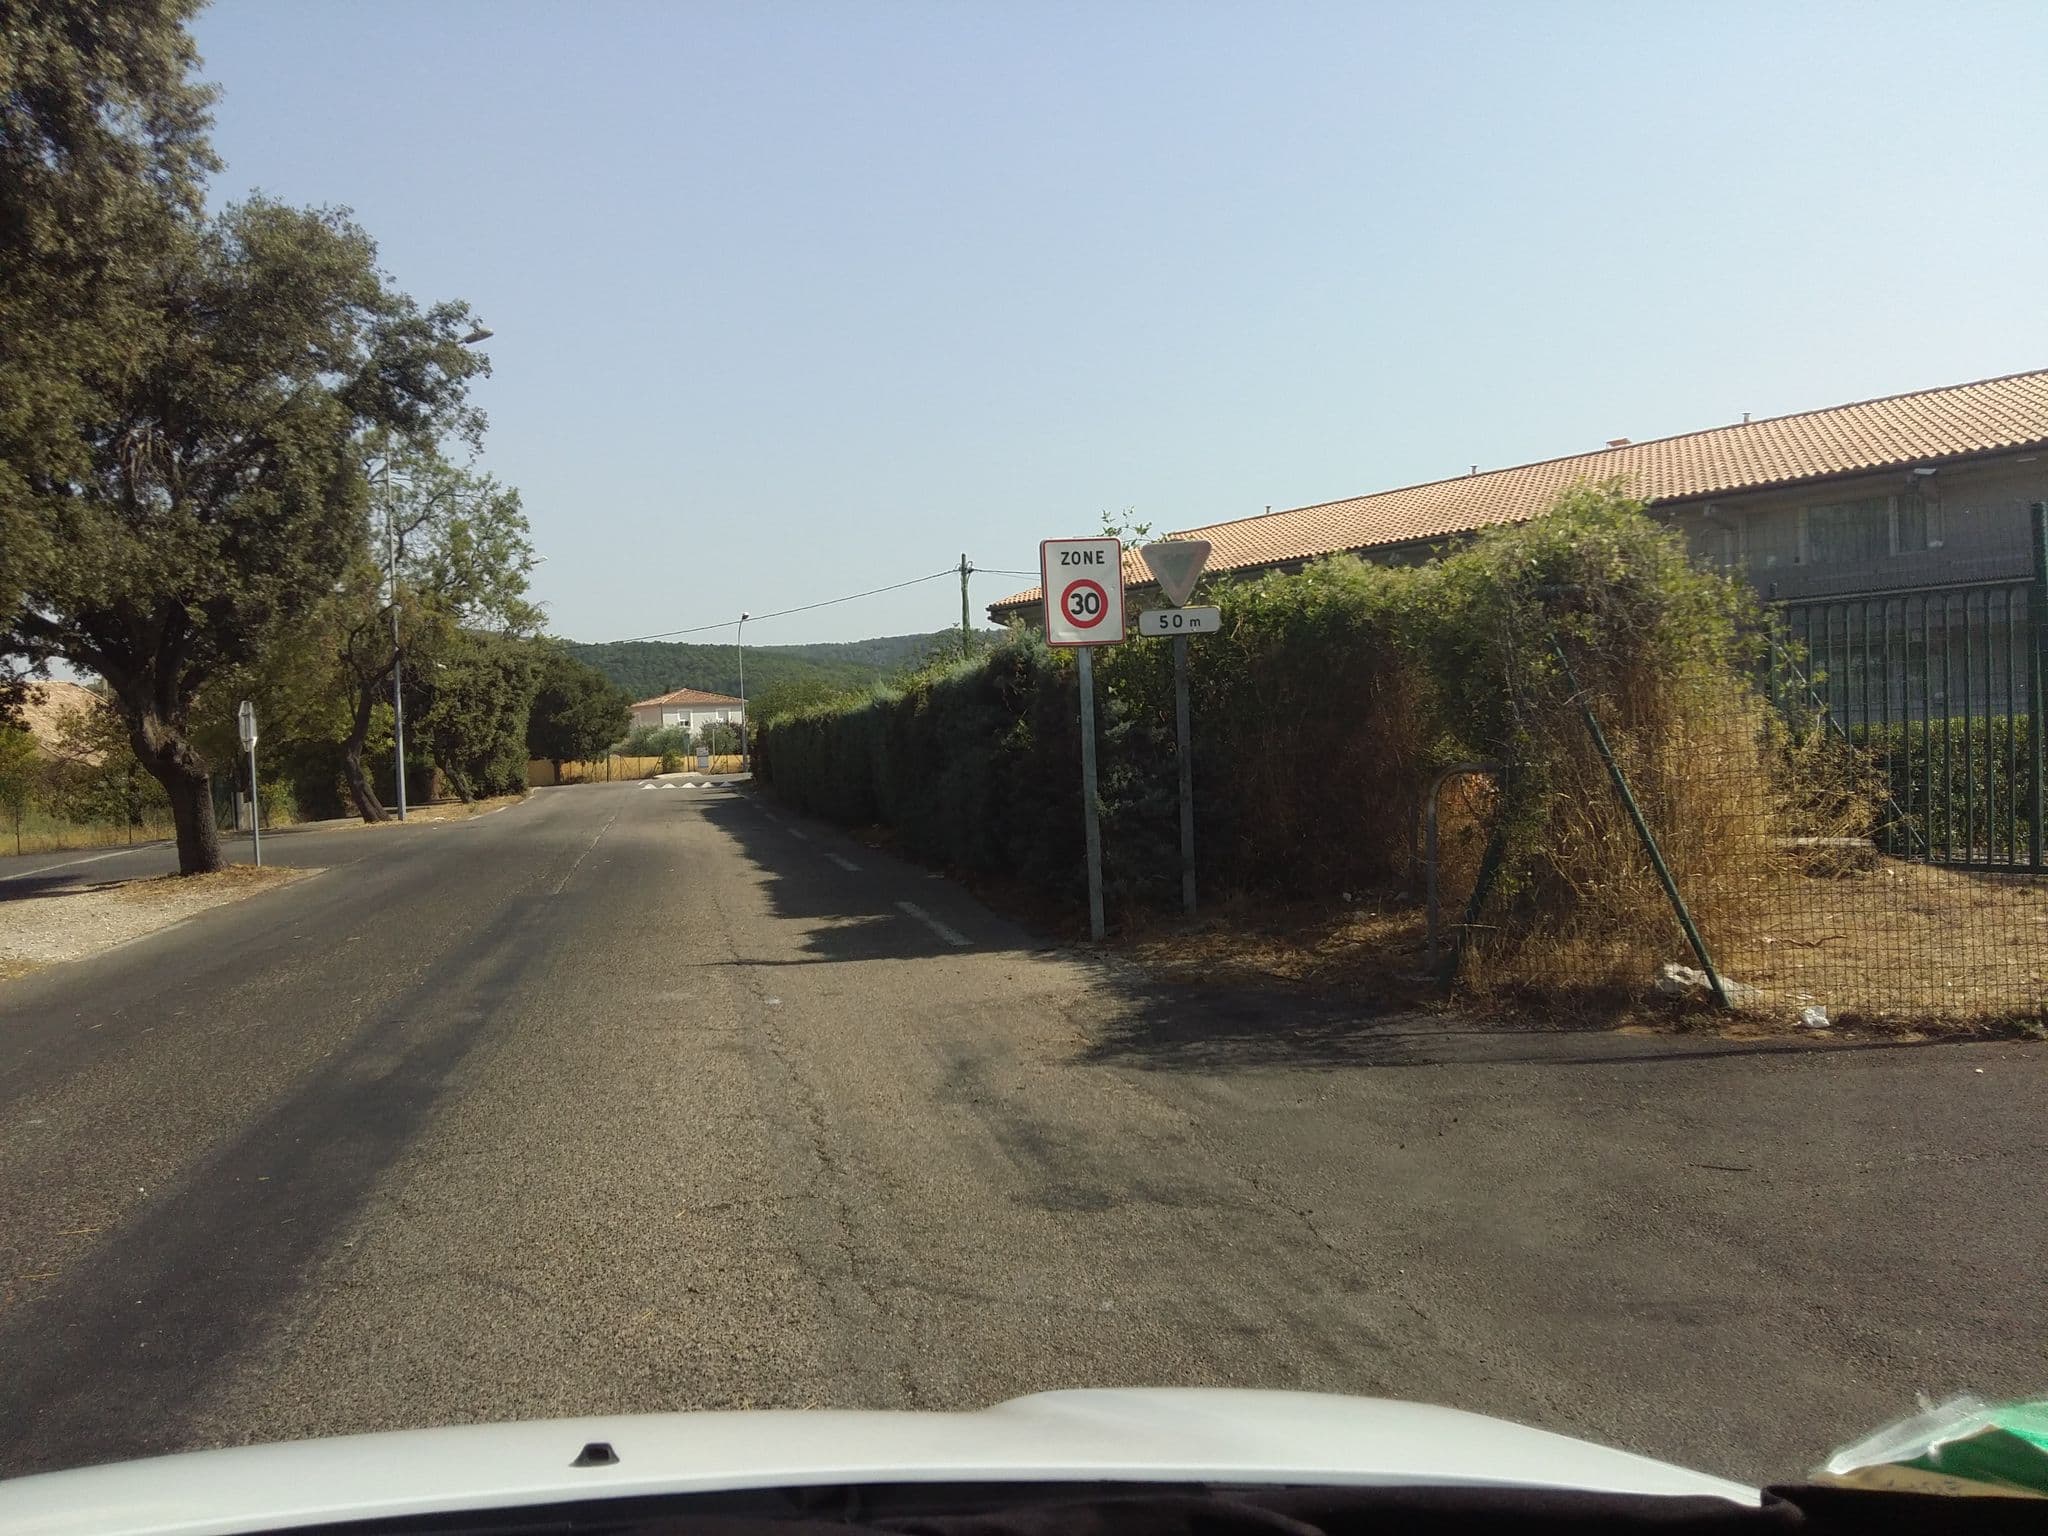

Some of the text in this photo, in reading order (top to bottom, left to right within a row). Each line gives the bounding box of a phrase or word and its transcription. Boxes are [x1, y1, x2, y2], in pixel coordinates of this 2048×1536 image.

[1060, 550, 1105, 566] ZONE
[1070, 592, 1100, 615] 30
[1159, 614, 1201, 629] 50 m
